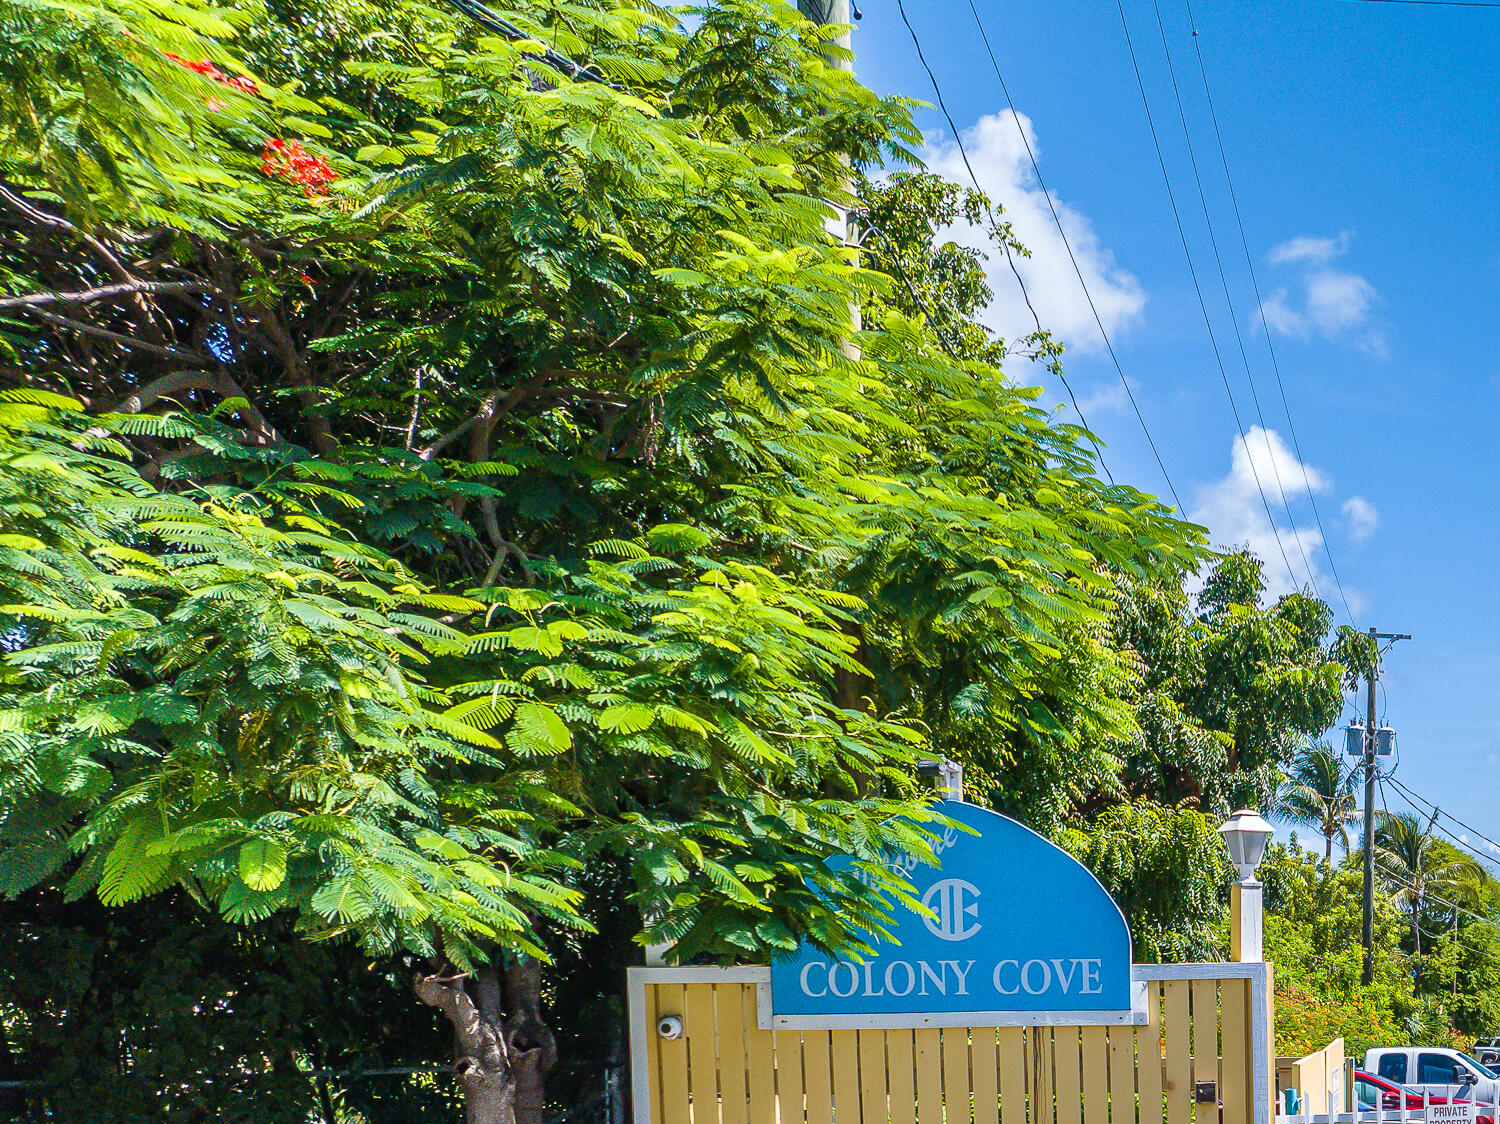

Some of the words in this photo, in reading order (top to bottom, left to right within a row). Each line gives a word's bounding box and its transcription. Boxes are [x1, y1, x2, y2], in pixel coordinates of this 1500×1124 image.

[800, 959, 976, 998] COLONY
[992, 958, 1103, 995] COVE
[1434, 1107, 1467, 1117] PRIVATE
